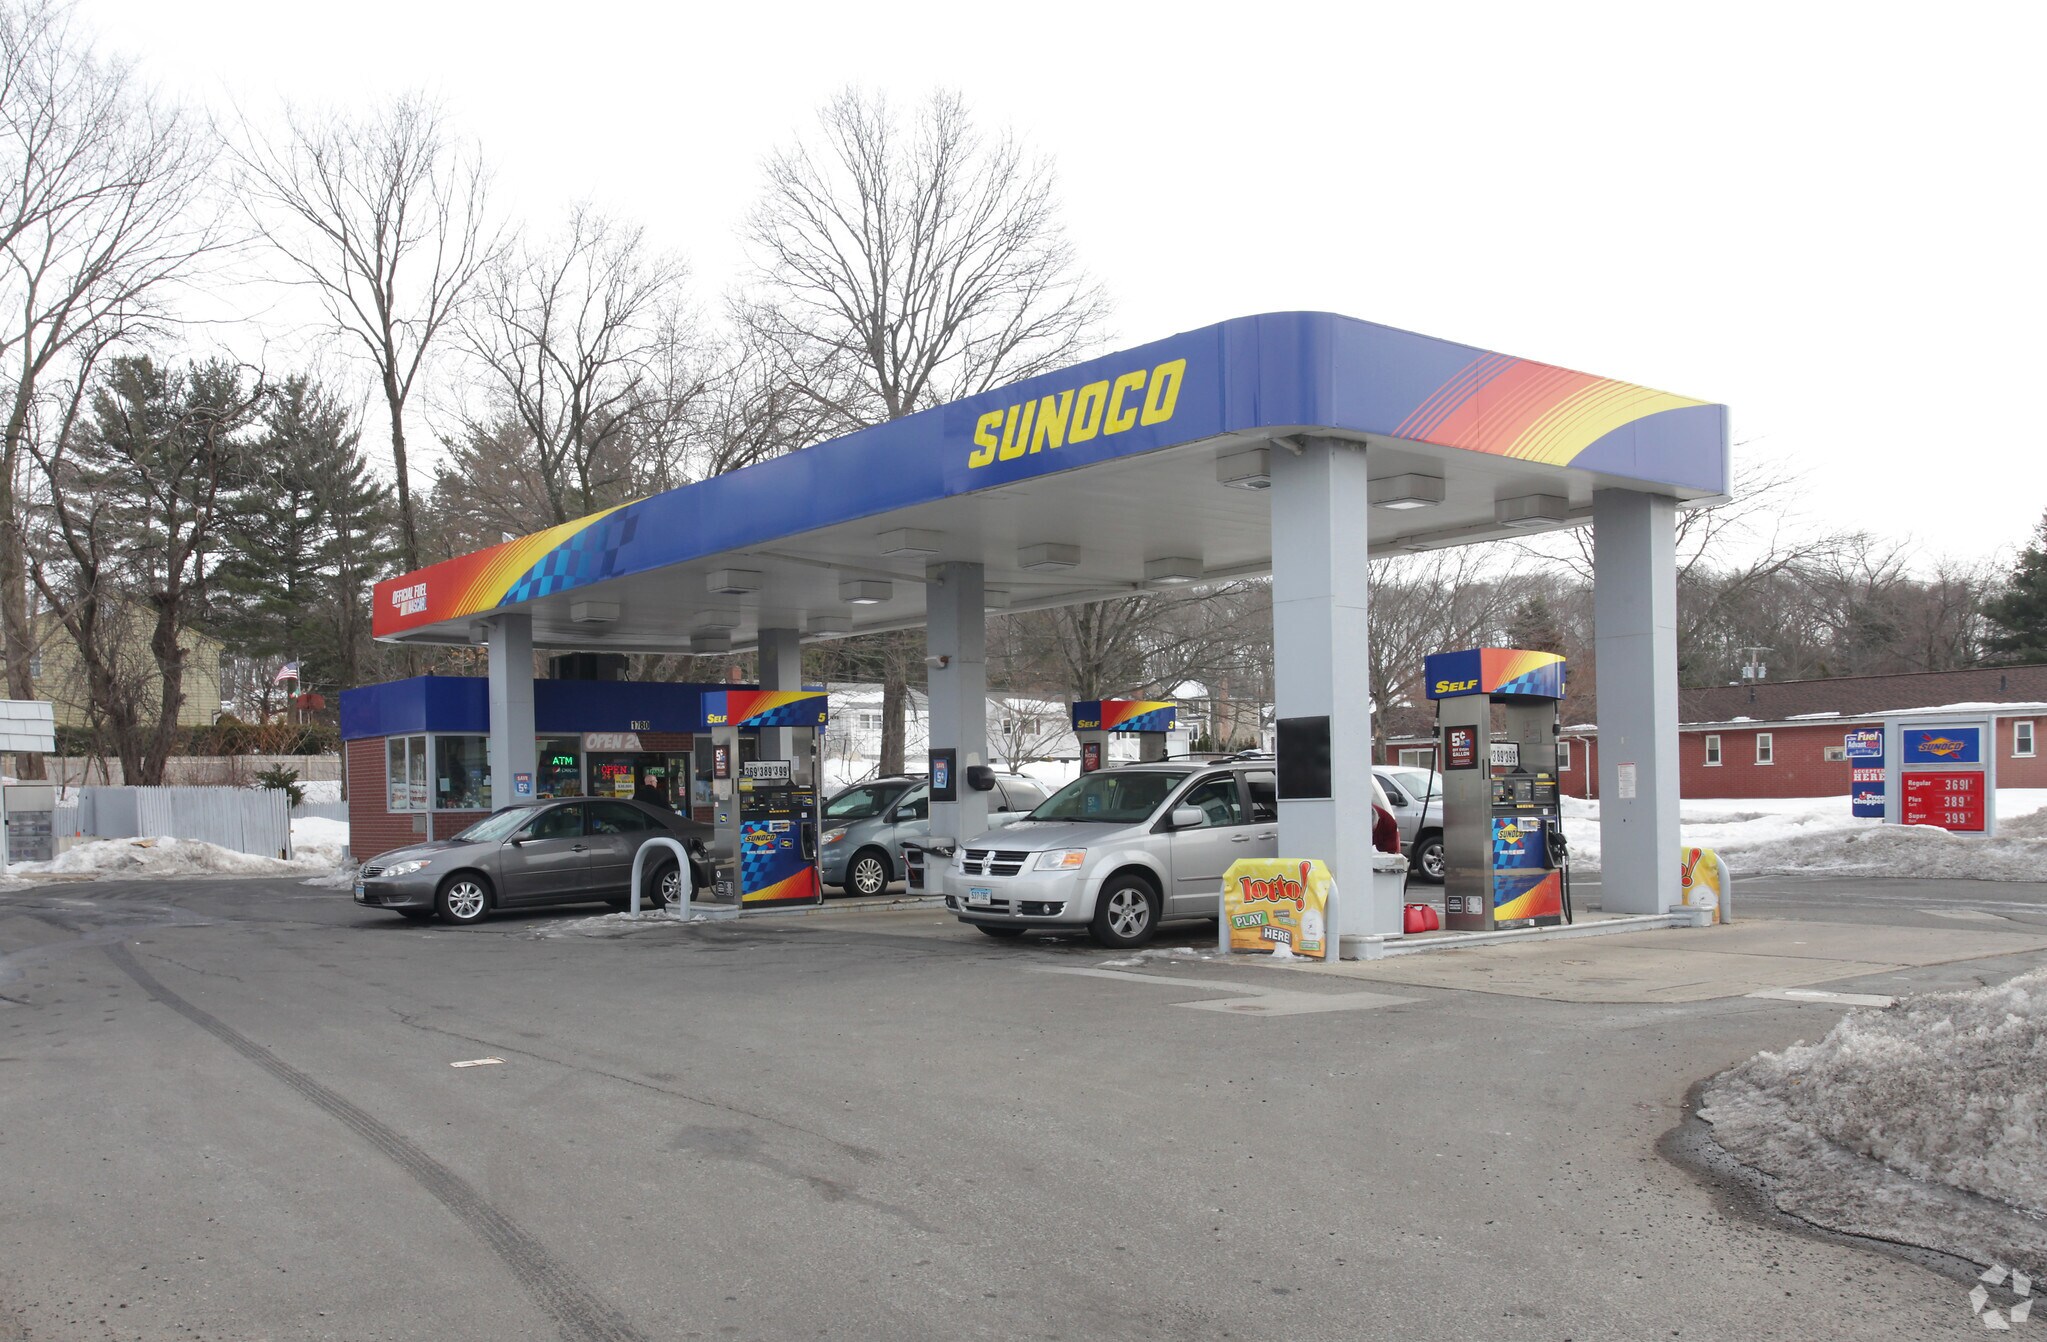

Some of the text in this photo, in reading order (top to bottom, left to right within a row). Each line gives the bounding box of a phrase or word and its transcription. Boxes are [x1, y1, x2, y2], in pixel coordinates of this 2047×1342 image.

[967, 358, 1187, 469] SUNOCO
[392, 582, 427, 605] OFFICIAL FUEL
[1434, 679, 1478, 694] SELF
[707, 713, 727, 724] SELF
[818, 712, 826, 723] 5
[631, 720, 650, 730] 1780
[1077, 719, 1100, 728] SELF
[1168, 721, 1175, 730] 3
[586, 733, 622, 749] OPEN
[1857, 731, 1879, 741] Fuel
[1920, 742, 1962, 751] SUNOCO
[552, 756, 573, 766] ATM
[601, 765, 628, 775] OPEN
[760, 766, 772, 777] 389
[1853, 773, 1885, 781] HERE
[1944, 796, 1965, 807] 389
[1945, 812, 1965, 824] 399
[746, 834, 776, 842] SUNOCO
[1235, 914, 1262, 928] PLAY
[1264, 927, 1290, 944] HERE
